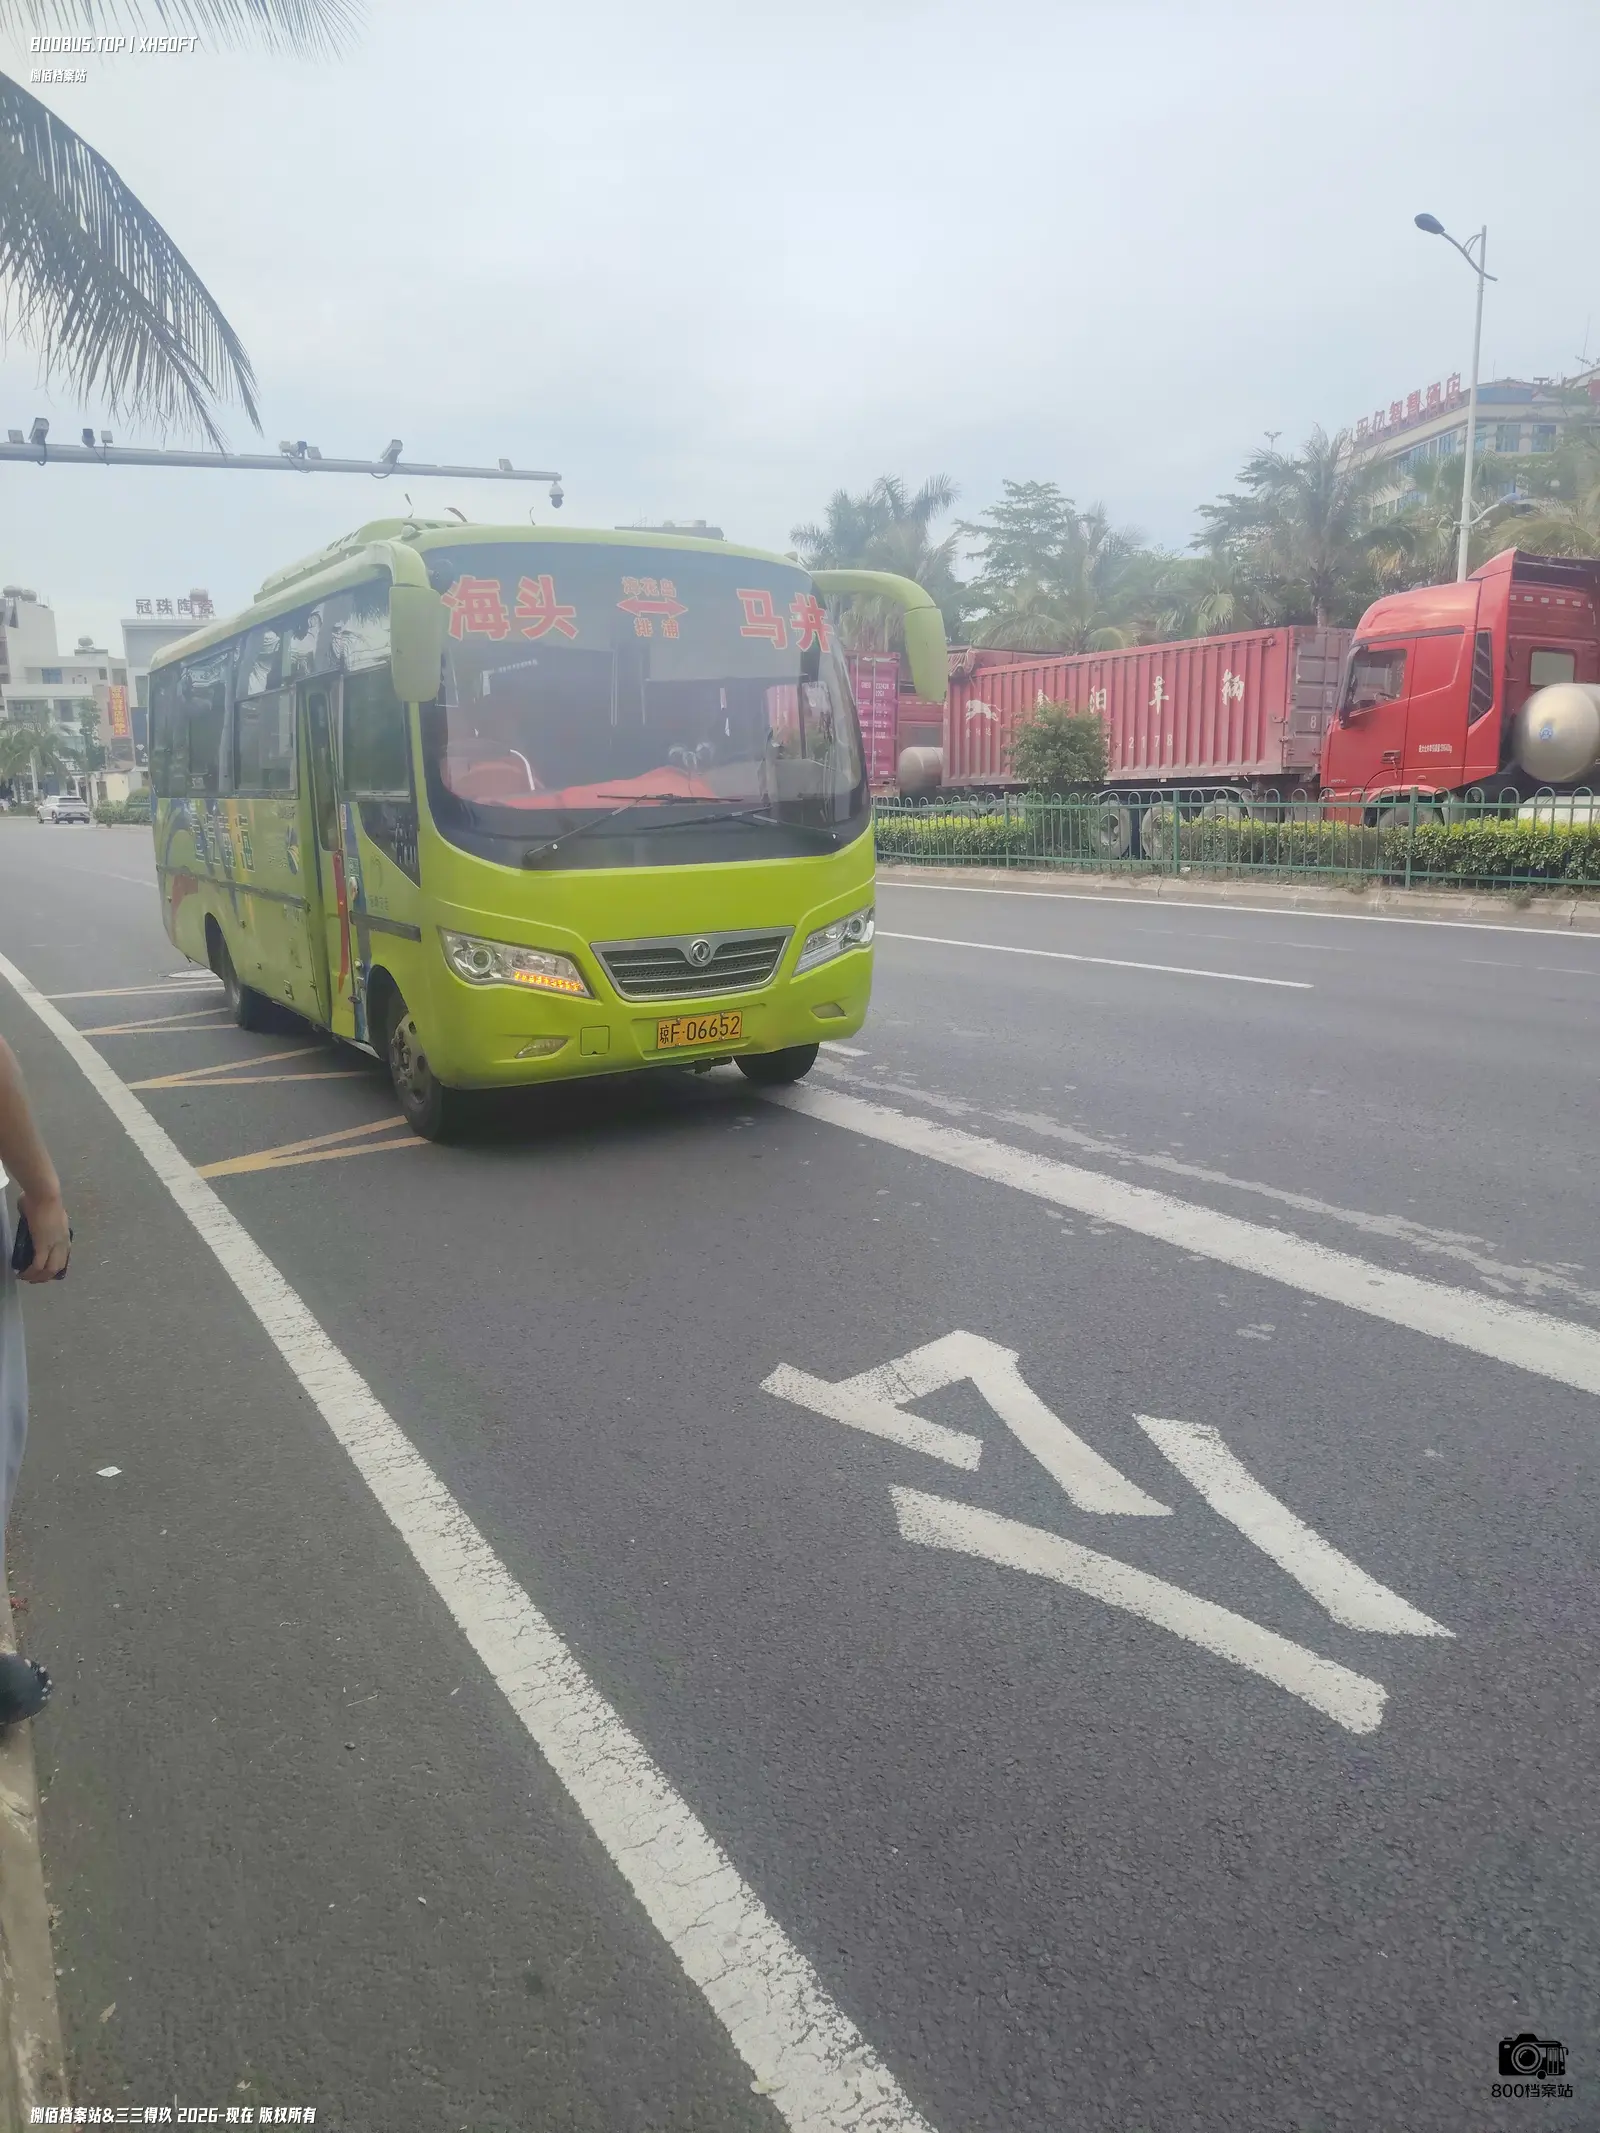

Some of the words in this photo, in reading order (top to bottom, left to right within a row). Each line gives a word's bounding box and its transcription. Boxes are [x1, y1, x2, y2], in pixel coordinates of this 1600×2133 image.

[621, 576, 677, 598] 海花岛
[136, 598, 214, 614] 冠珠陶瓷
[441, 575, 580, 641] 海头
[633, 617, 680, 638] 排浦
[736, 588, 835, 653] 马井
